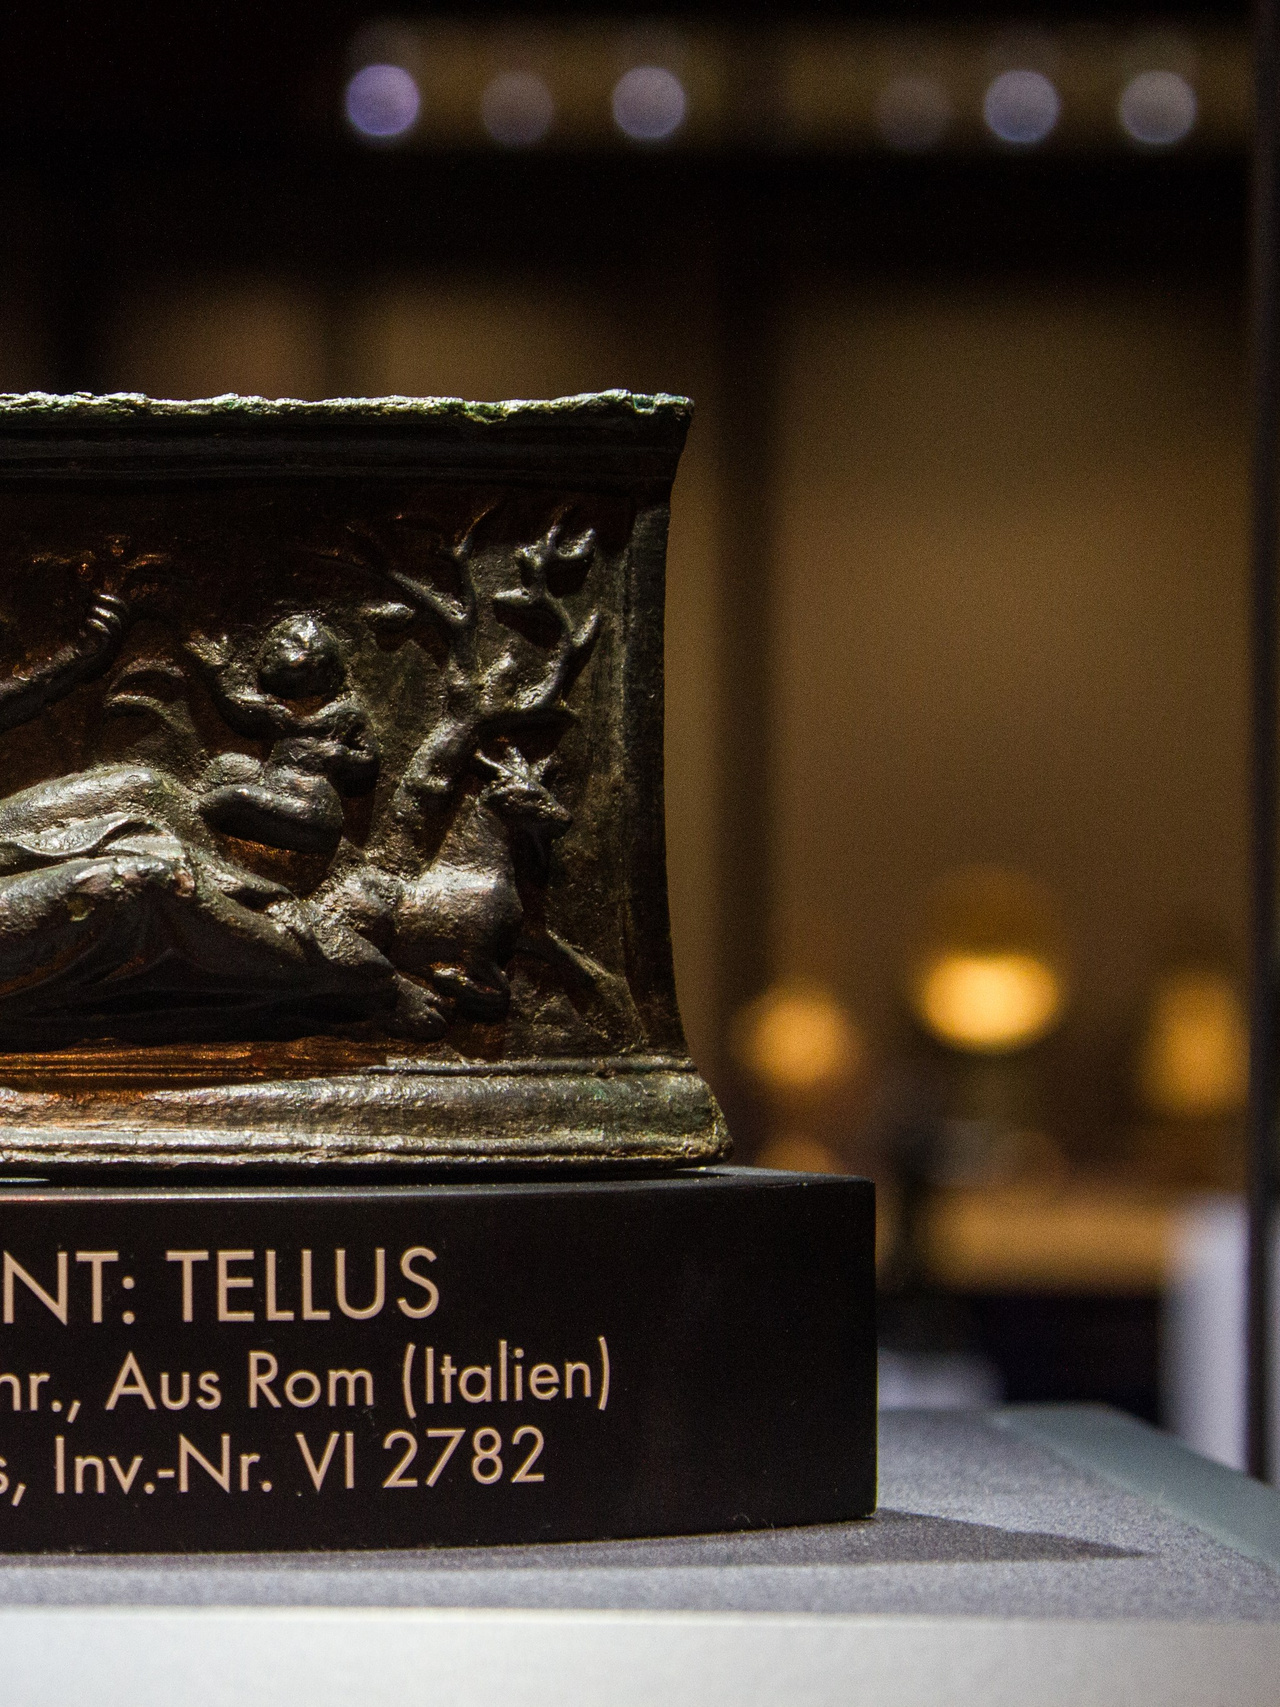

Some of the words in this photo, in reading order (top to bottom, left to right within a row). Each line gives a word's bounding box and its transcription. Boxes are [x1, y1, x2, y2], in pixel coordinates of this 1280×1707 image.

[166, 1247, 439, 1322] TELLUS
[105, 1353, 221, 1411] Aus
[249, 1352, 374, 1408] Rom
[403, 1336, 610, 1419] (Italien)
[52, 1433, 272, 1494] Inv.-Nr.
[296, 1432, 355, 1492] VI
[383, 1426, 545, 1489] 2782
